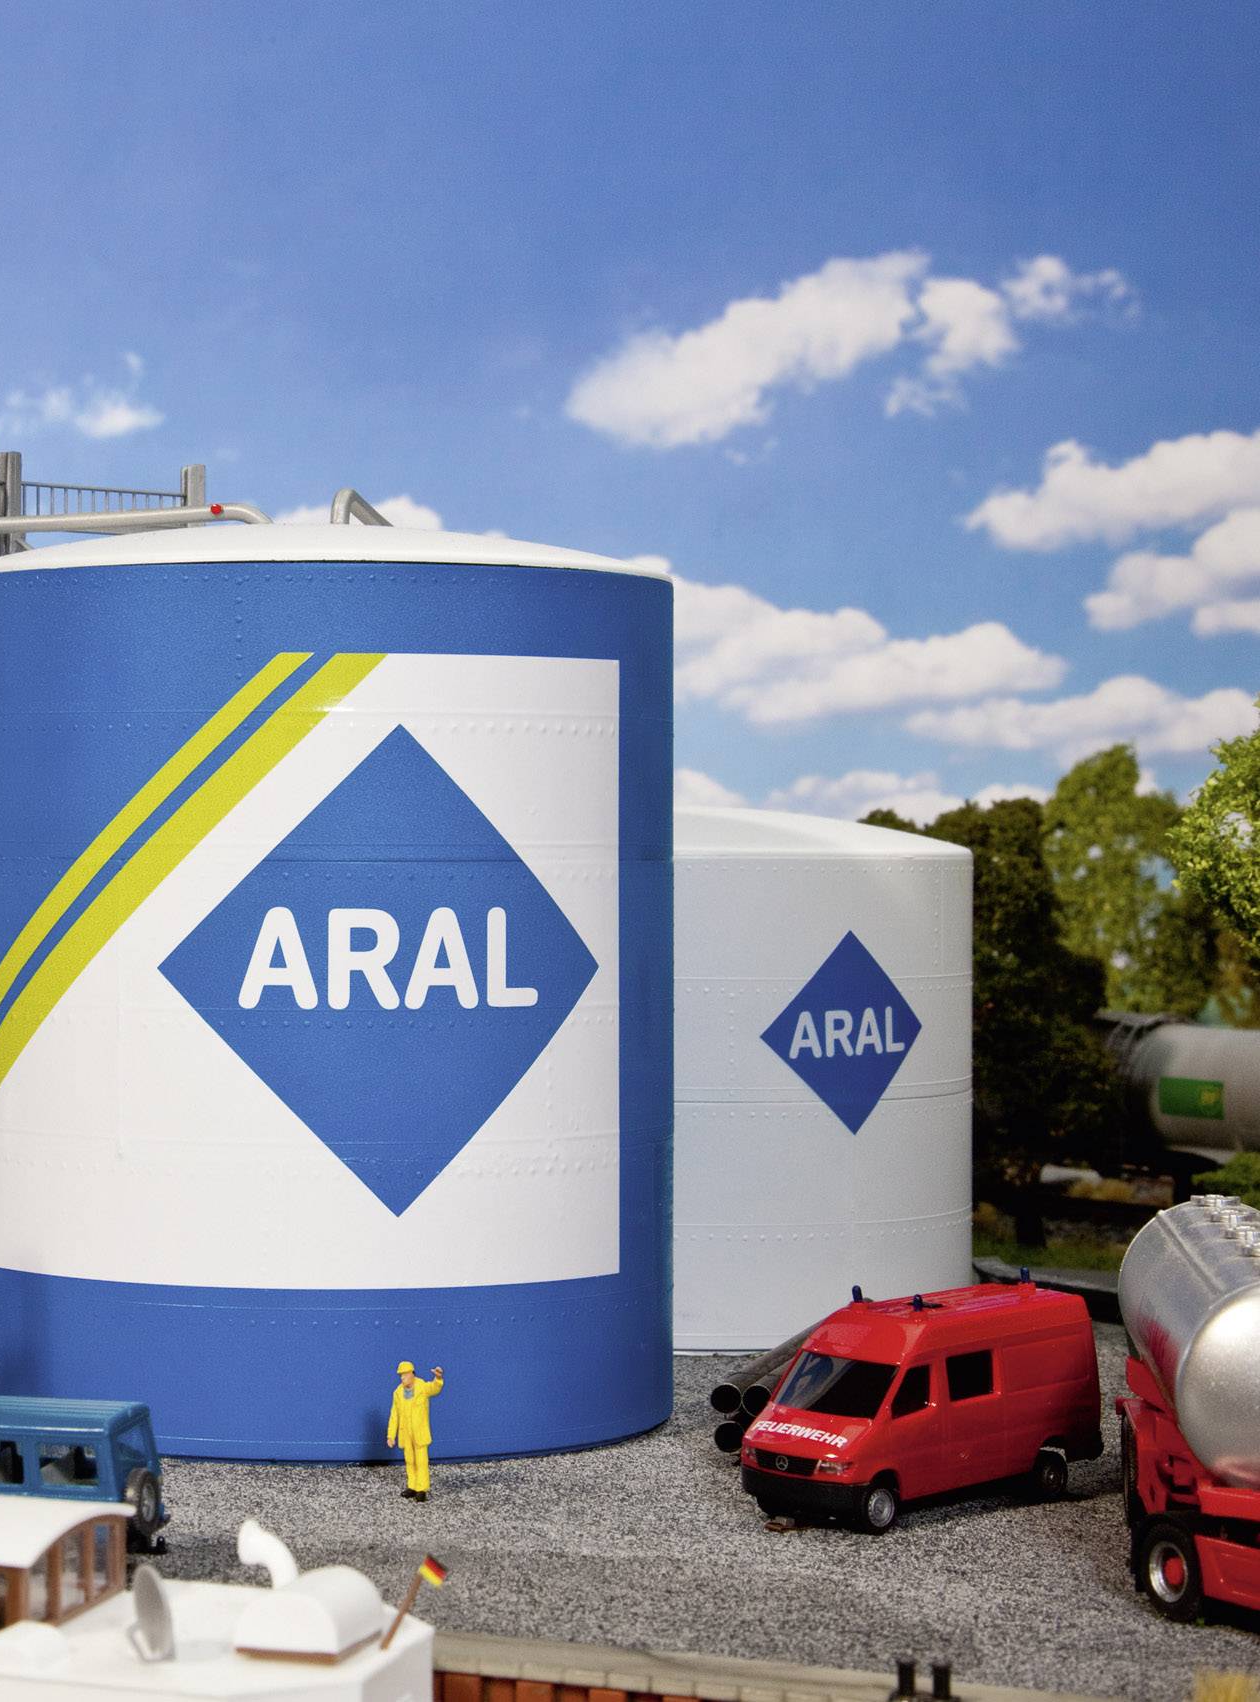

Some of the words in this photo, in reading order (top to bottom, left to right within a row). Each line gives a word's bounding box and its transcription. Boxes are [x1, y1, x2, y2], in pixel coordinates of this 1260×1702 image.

[238, 906, 539, 1010] ARAL
[789, 1006, 905, 1059] ARAL
[752, 1421, 848, 1448] FEUERWEHR
